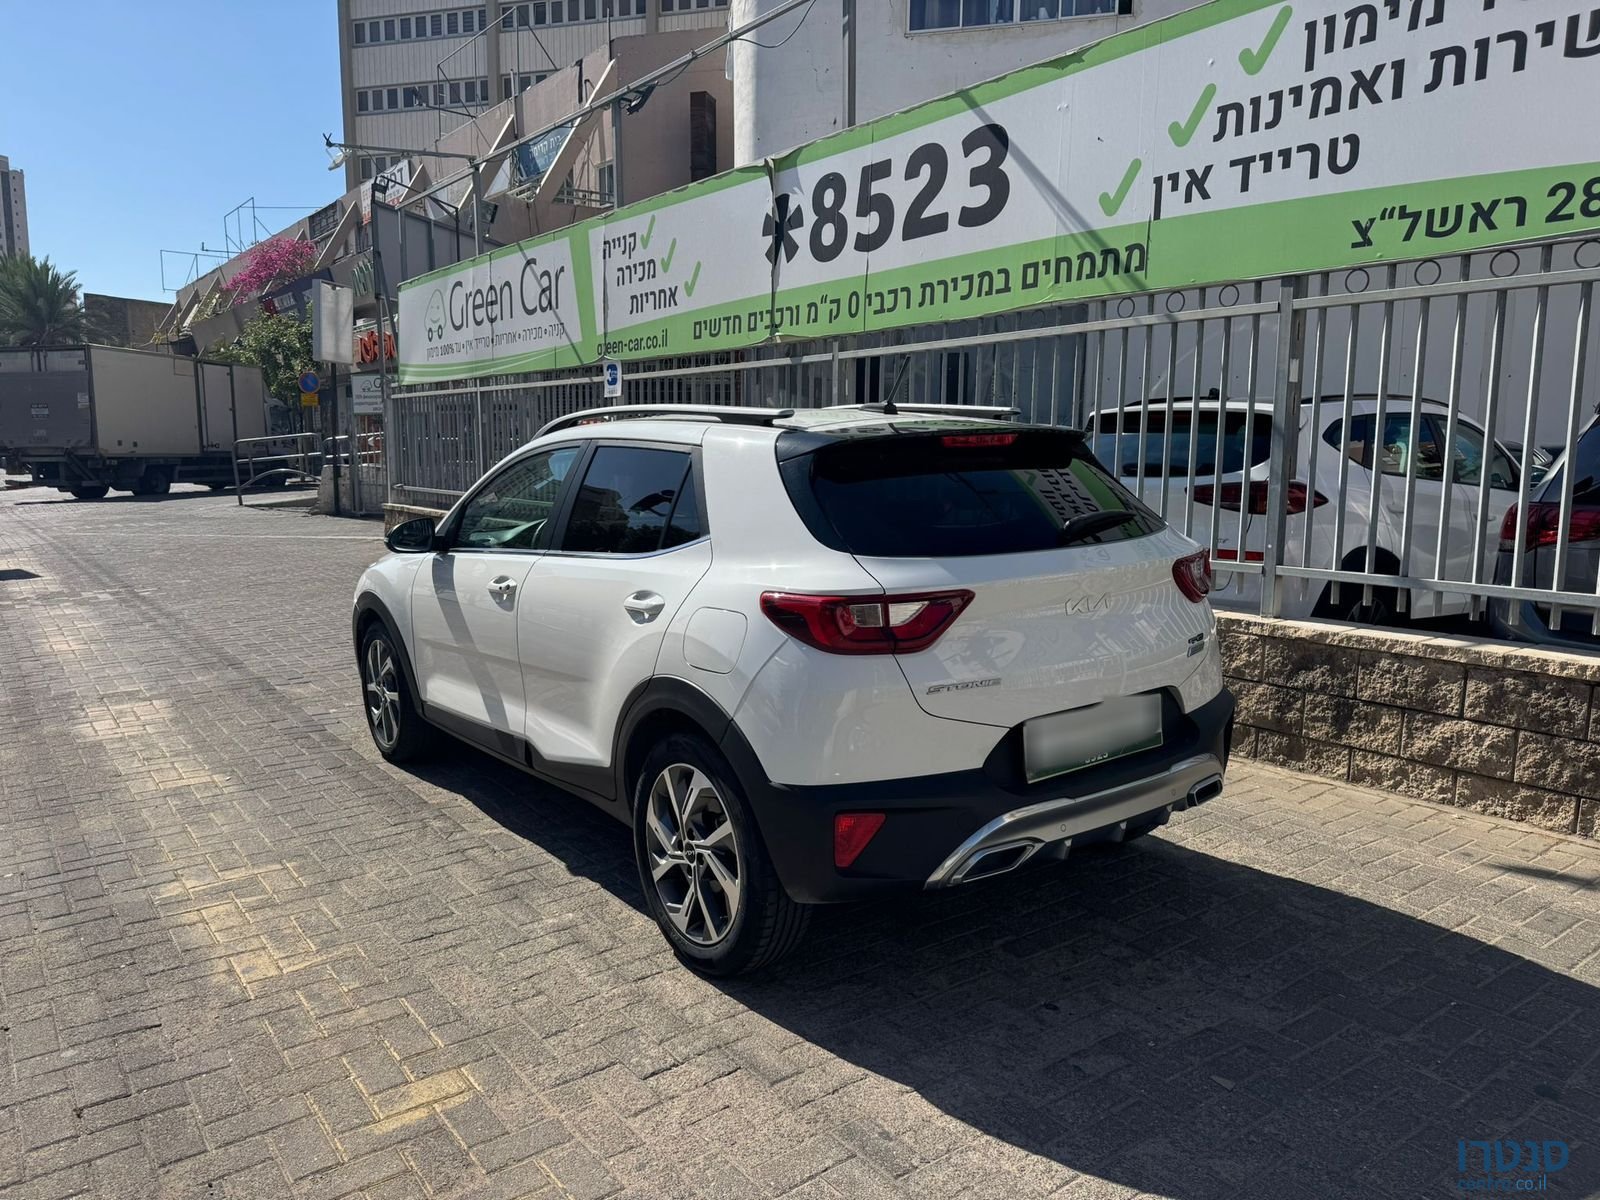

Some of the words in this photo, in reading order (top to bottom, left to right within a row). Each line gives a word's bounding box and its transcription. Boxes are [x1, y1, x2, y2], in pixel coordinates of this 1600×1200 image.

[1304, 0, 1446, 72] מימון
[1424, 8, 1600, 94] שירות
[1213, 58, 1406, 142] ואמינות
[1229, 132, 1360, 194] טרייד
[1152, 164, 1214, 222] אין
[1545, 176, 1600, 225] 28
[602, 231, 637, 260] קנייה
[617, 258, 657, 287] מכירה
[1021, 242, 1146, 291] מתמחים
[449, 280, 514, 332] Green
[520, 257, 565, 316] Car
[629, 285, 679, 315] אחריות
[866, 285, 912, 315] רכבי
[918, 267, 1012, 308] במכירת
[747, 304, 801, 334] ורכבים
[848, 290, 860, 319] 0
[494, 331, 517, 346] אחריות
[522, 326, 543, 342] מכירה
[548, 322, 565, 340] קניה
[693, 314, 742, 340] חדשים
[440, 343, 455, 357] 100%
